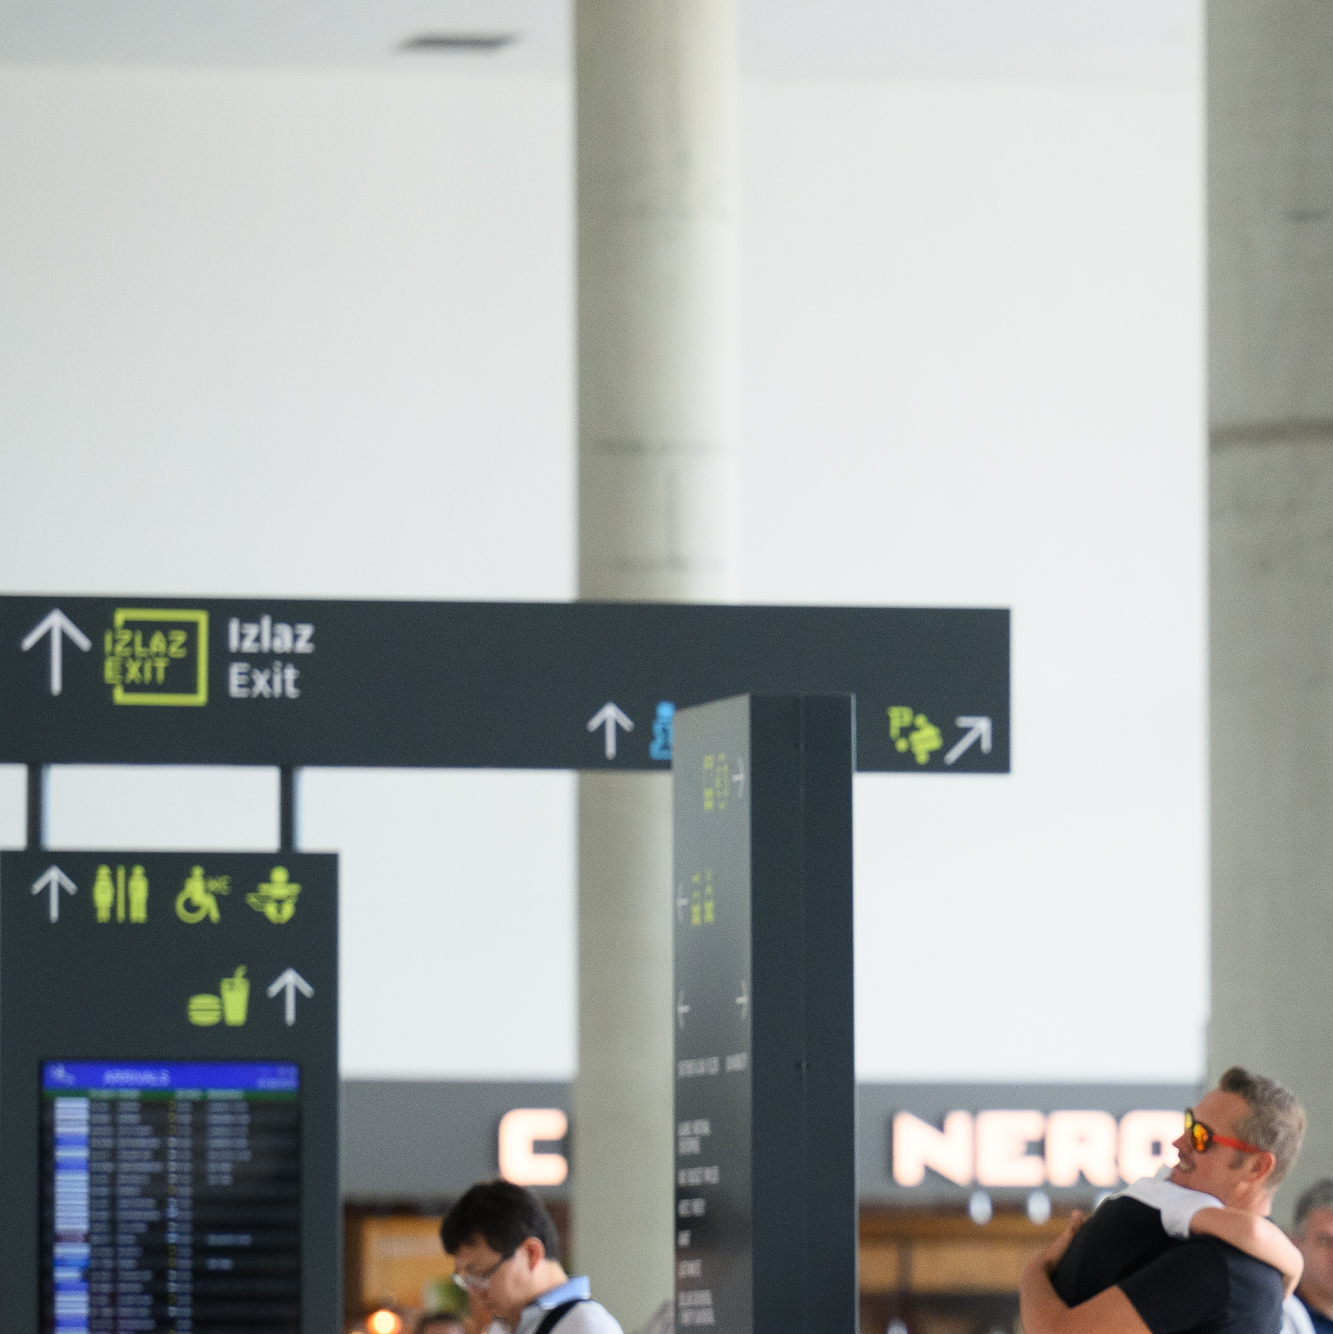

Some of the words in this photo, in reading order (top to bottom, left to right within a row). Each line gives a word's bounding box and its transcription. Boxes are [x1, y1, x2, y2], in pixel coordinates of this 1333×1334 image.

[104, 629, 187, 658] IZLAZ
[228, 614, 315, 654] Izlaz
[104, 656, 170, 685] EXIT
[228, 660, 301, 699] Exit
[893, 1109, 1188, 1188] NERO
